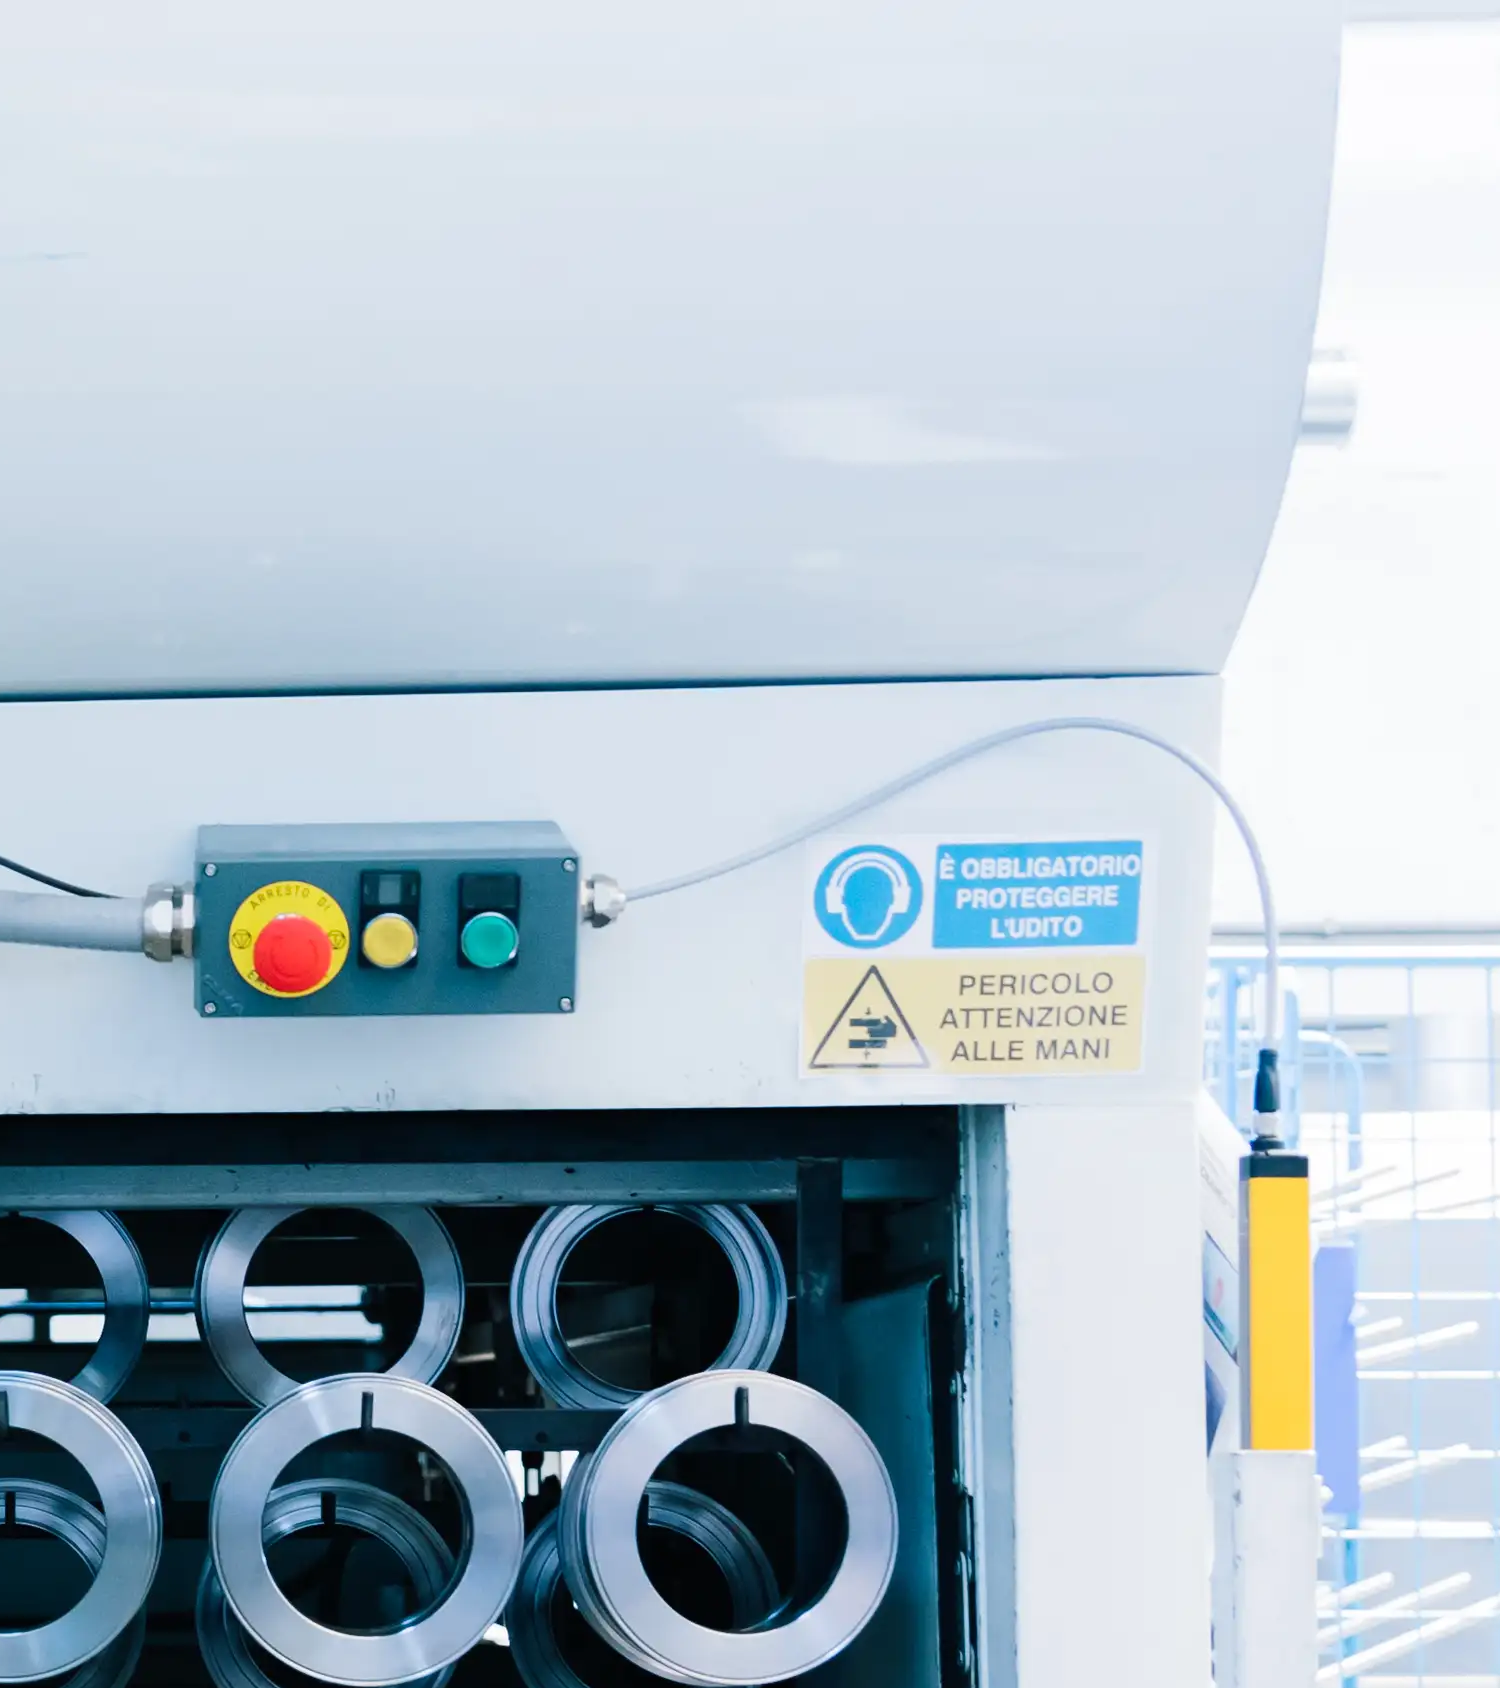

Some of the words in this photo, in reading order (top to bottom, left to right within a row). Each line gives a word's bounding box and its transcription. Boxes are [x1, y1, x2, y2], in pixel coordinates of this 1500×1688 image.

[939, 853, 955, 880] È
[961, 854, 1142, 880] OBBLIGATORIO
[249, 884, 311, 910] ARRESTO
[316, 896, 331, 912] DI
[955, 885, 1119, 910] PROTEGGERE
[990, 916, 1083, 940] L'UDITO
[959, 972, 1114, 996] PERICOLO
[939, 1004, 1128, 1030] ATTENZIONE
[951, 1040, 1024, 1062] ALLE
[1035, 1038, 1111, 1060] MANI
